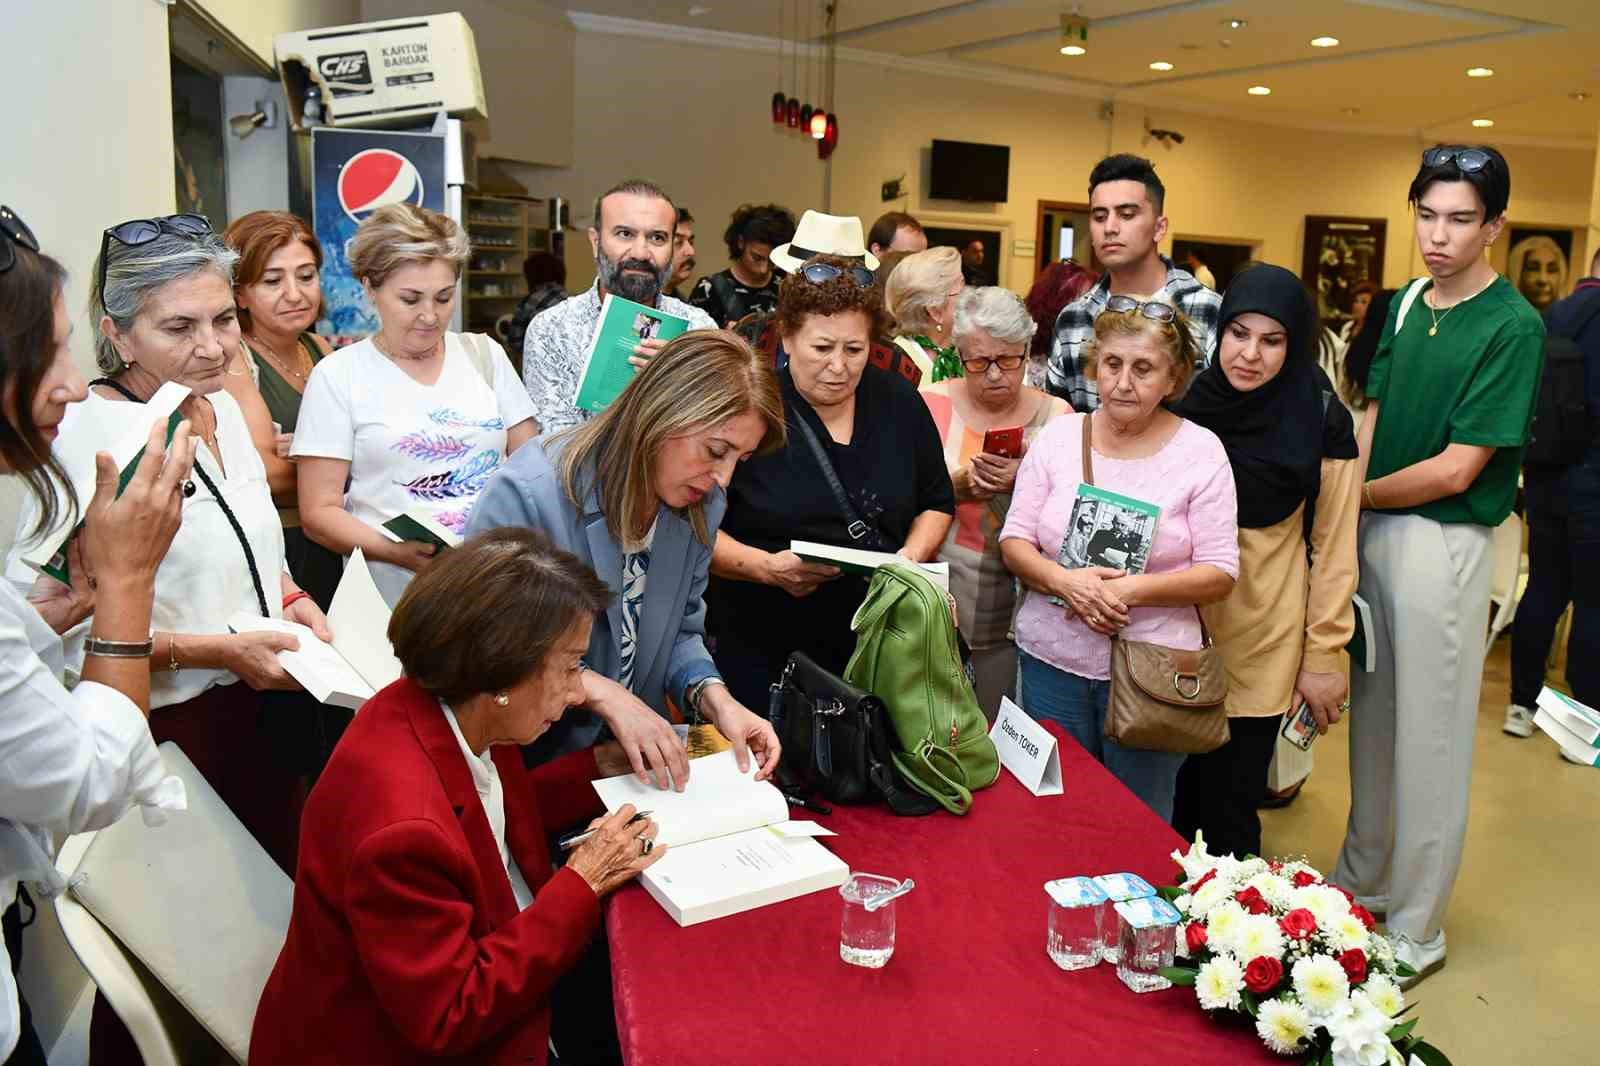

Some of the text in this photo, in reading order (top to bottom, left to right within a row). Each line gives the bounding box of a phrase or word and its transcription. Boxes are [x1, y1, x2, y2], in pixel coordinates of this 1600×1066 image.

[382, 43, 428, 56] KARTON
[384, 55, 430, 68] BARDAK
[1001, 718, 1039, 760] Özden TOKER
